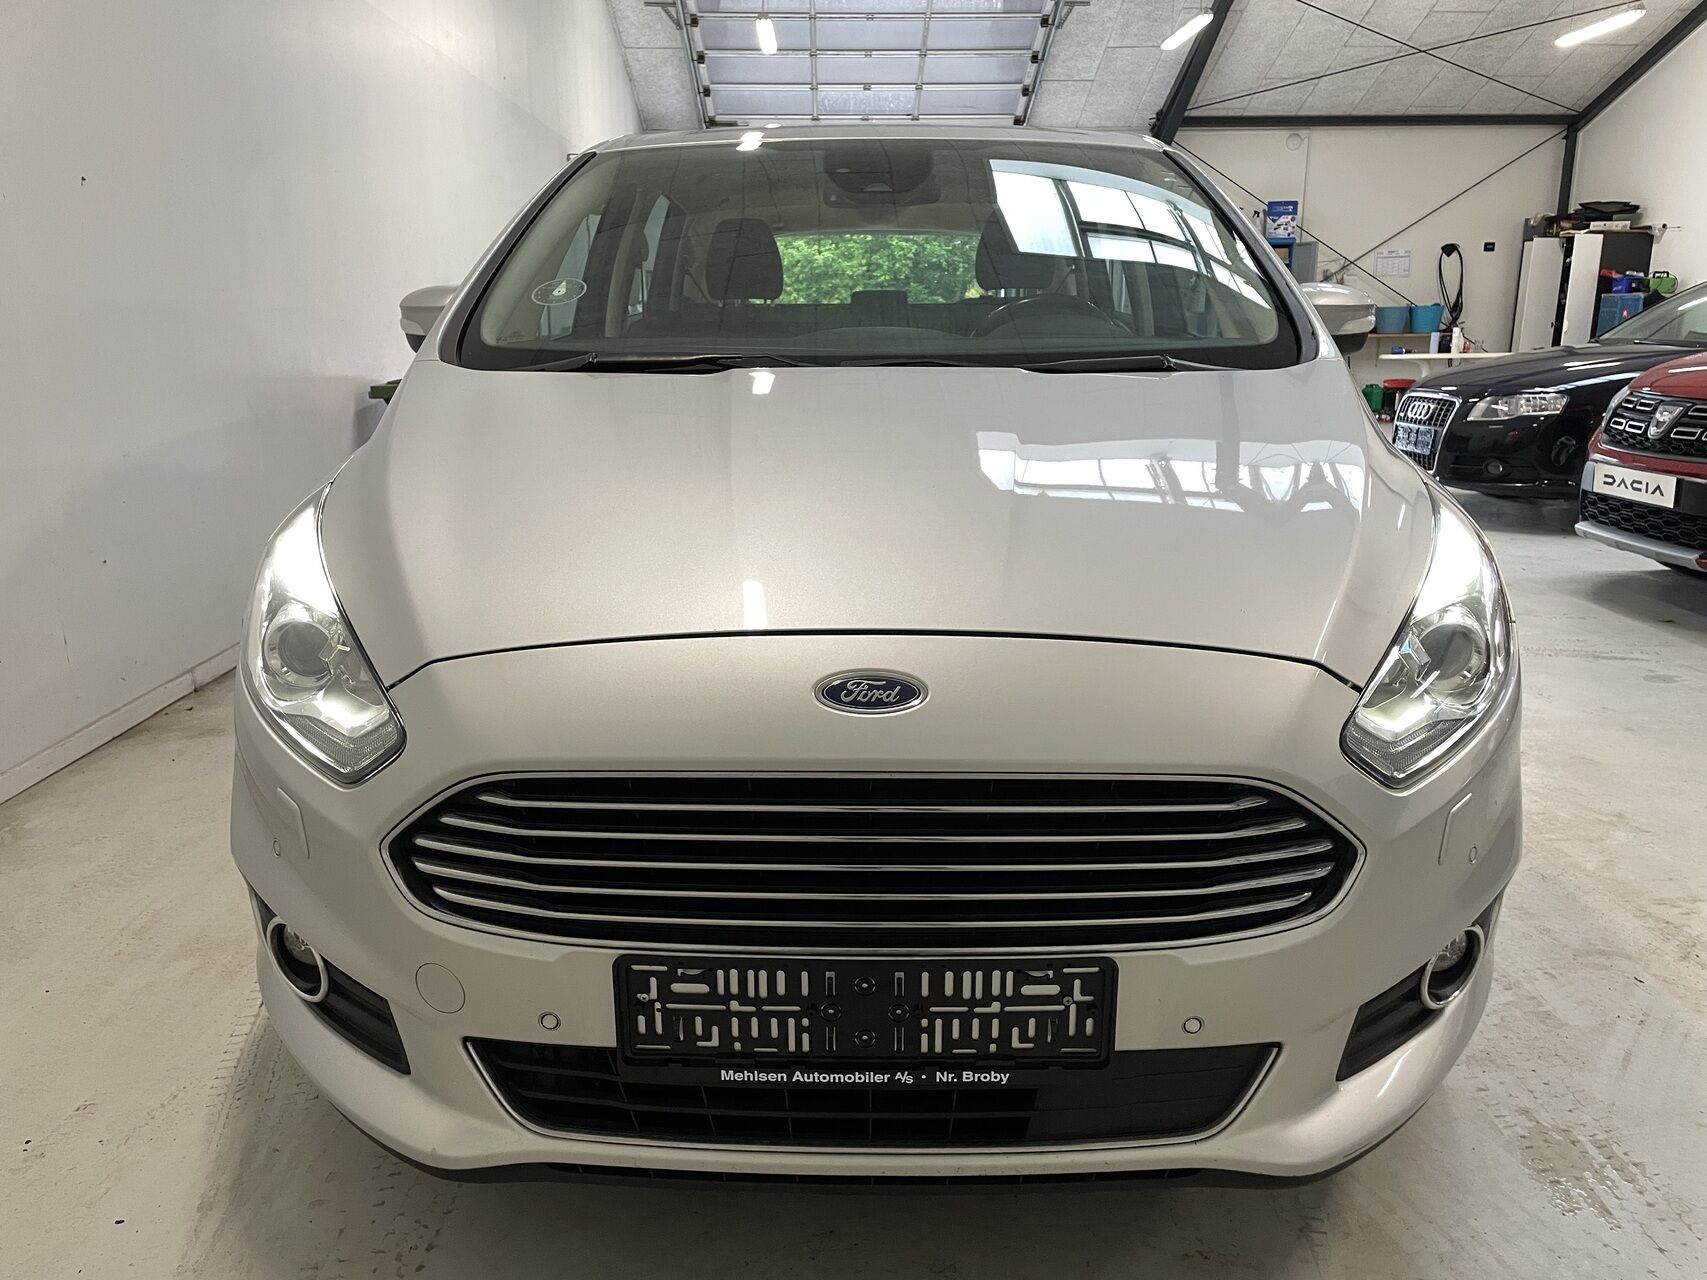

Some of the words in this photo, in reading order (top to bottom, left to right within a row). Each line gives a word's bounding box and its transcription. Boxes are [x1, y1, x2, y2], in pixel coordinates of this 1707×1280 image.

[1603, 473, 1665, 497] DACIA
[840, 679, 902, 703] Ford
[720, 1069, 788, 1082] Mehlsen
[791, 1070, 891, 1083] Automobiler
[935, 1071, 958, 1082] Nr.
[962, 1071, 1010, 1085] Broby
